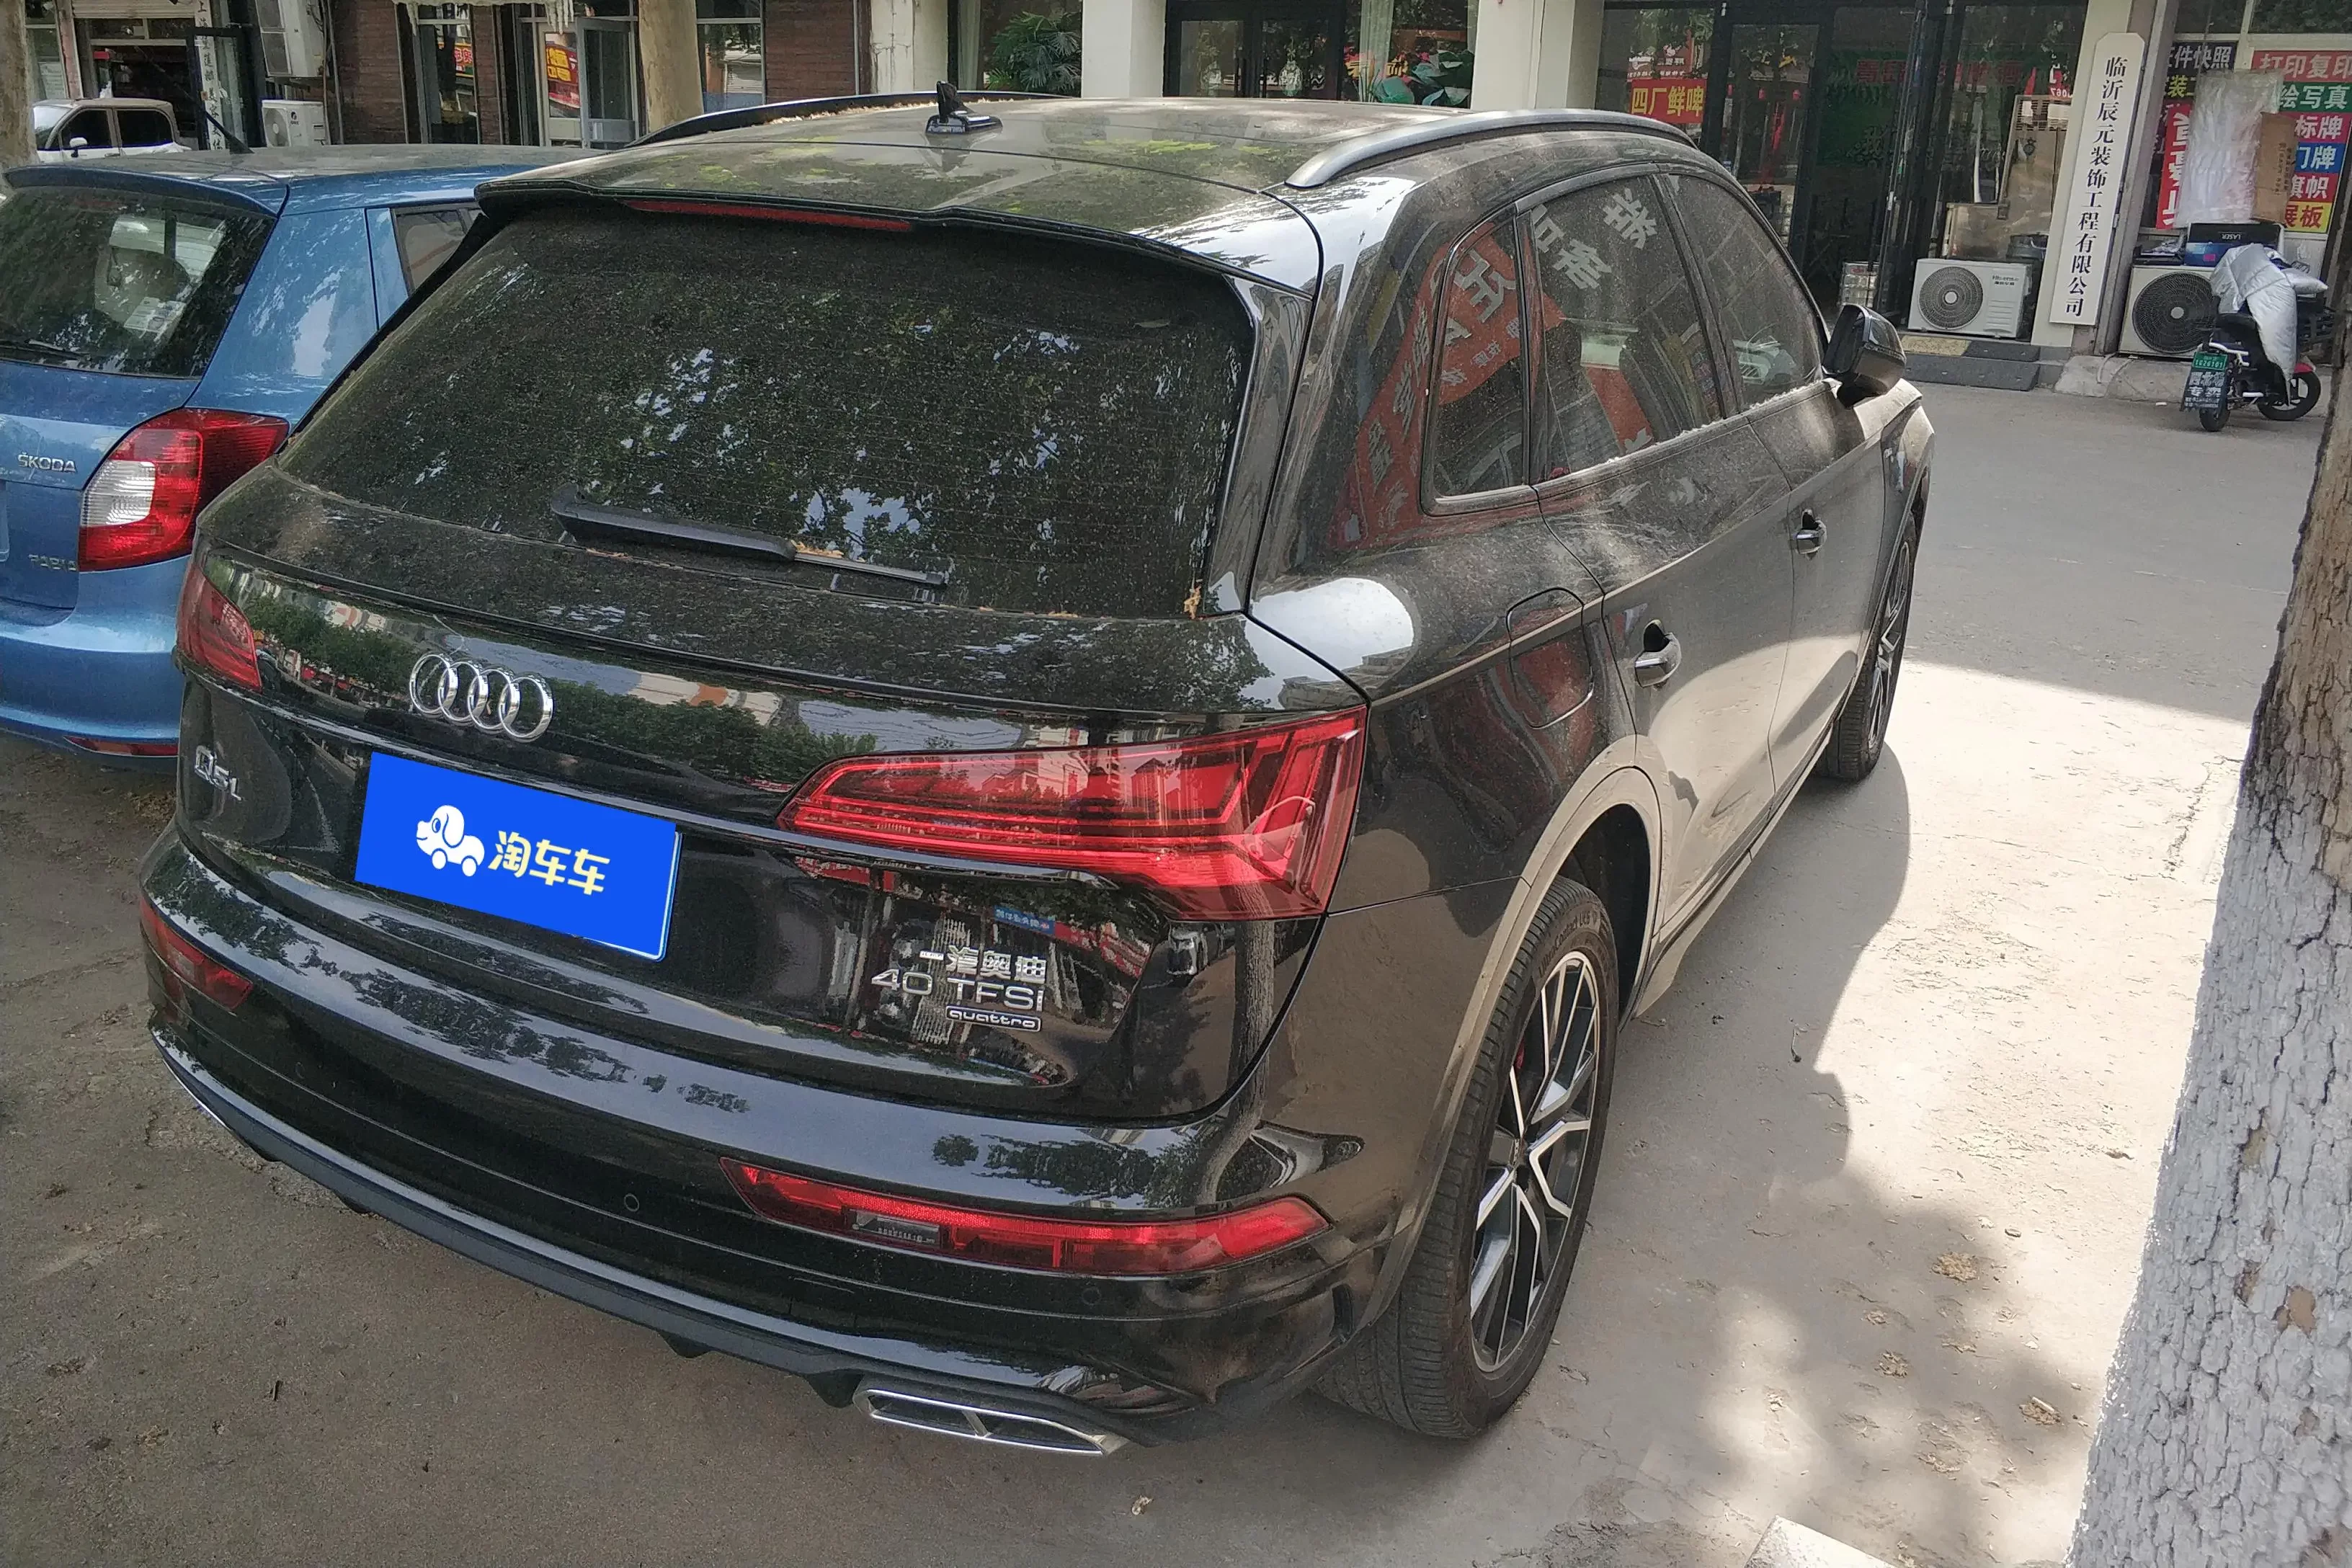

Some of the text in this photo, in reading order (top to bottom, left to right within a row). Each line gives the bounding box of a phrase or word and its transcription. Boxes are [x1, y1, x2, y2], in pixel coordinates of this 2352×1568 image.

[1631, 86, 1704, 117] 四厂鲜啤
[2295, 115, 2343, 139] 标牌
[2066, 56, 2128, 317] 临沂辰元装饰工程有限公司
[17, 452, 76, 472] ŠKODA
[195, 745, 241, 801] Q5L
[919, 945, 1046, 984] 一汽奥迪
[871, 968, 1044, 1012] 40 TFSI
[949, 1010, 1035, 1028] quattro
